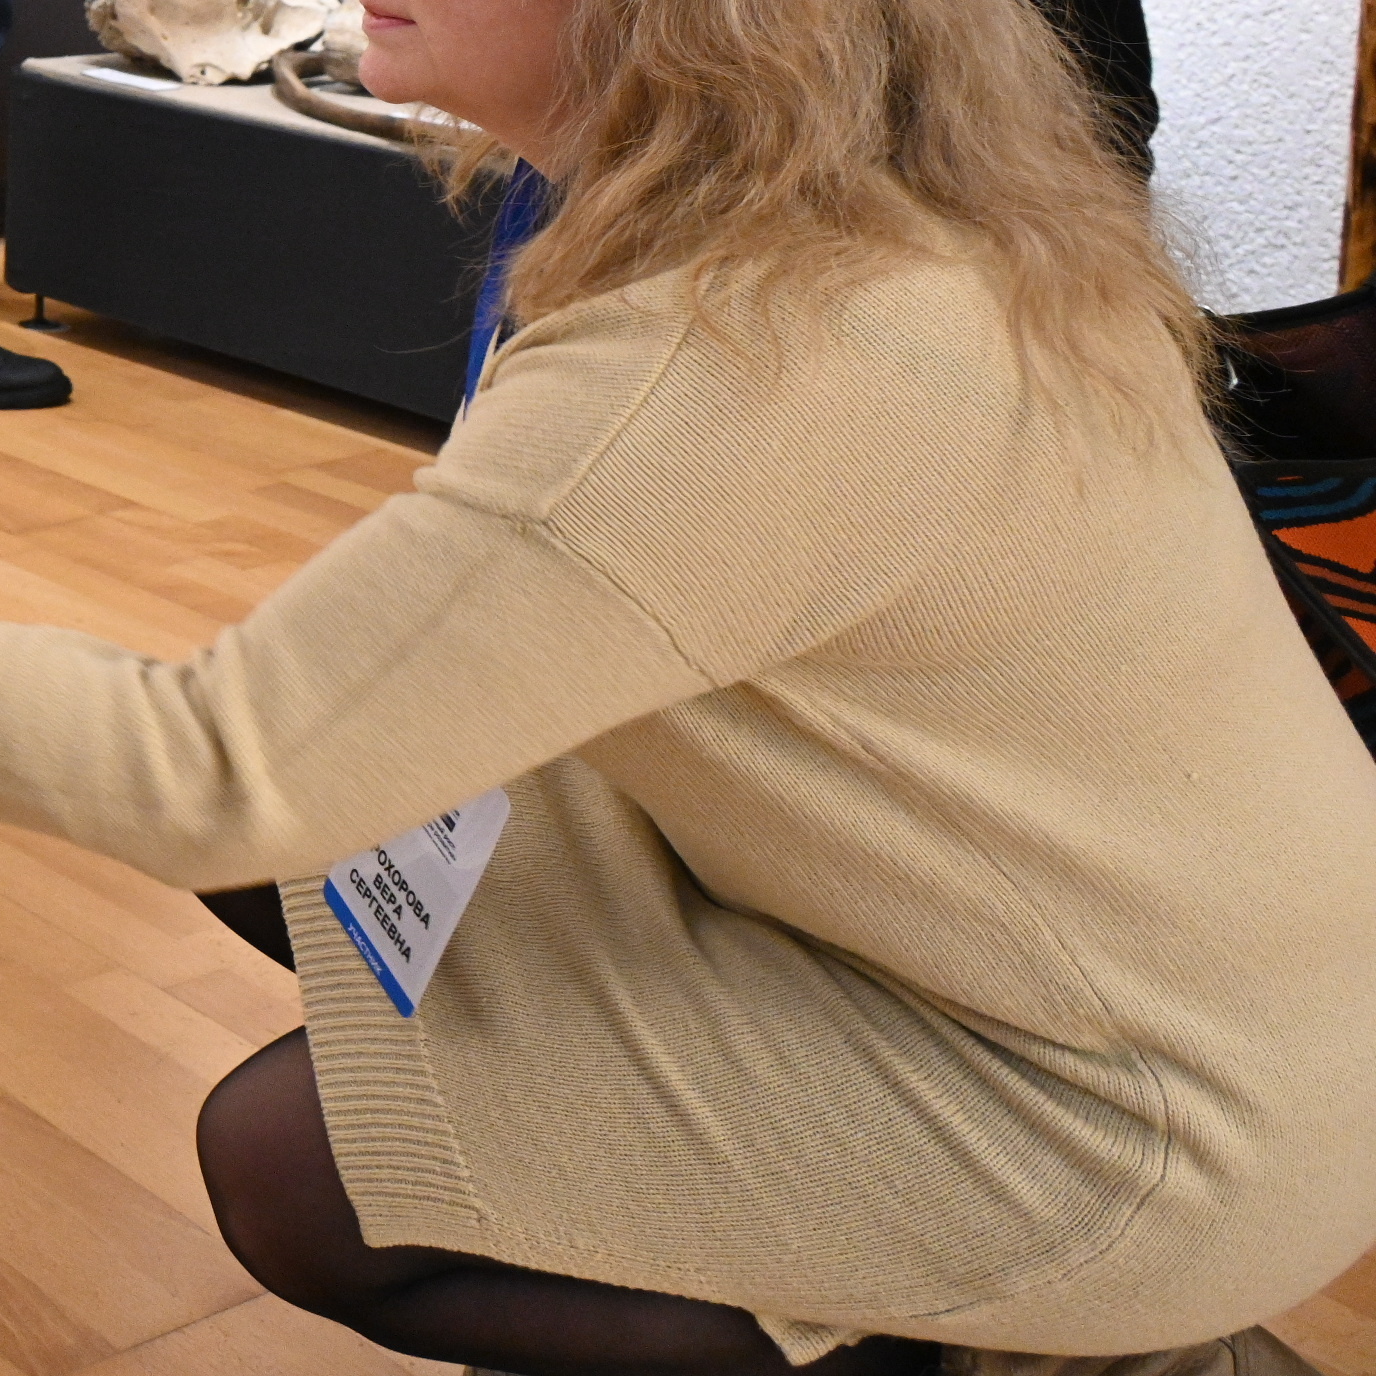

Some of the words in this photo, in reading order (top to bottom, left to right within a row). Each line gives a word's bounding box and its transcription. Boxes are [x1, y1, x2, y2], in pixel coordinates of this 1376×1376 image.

[349, 868, 411, 963] СЕРГЕЕВНА
[373, 872, 403, 921] ВЕРА
[348, 926, 383, 975] УЧАСТНИК
